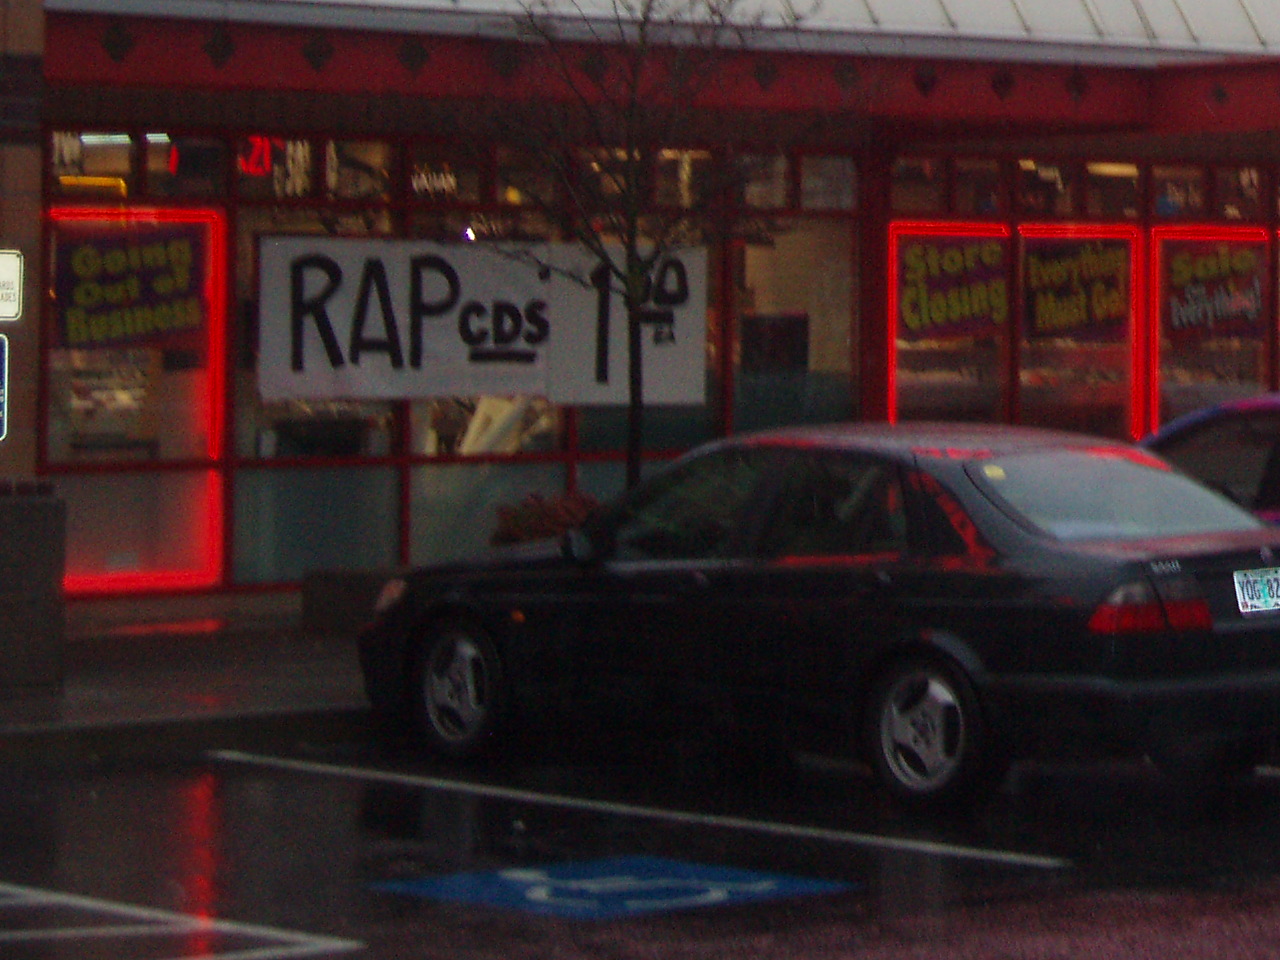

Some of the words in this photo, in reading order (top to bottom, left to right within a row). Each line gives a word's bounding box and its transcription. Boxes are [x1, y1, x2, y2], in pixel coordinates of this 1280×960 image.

[904, 242, 1003, 281] Store
[290, 254, 461, 371] RAP
[901, 279, 1008, 331] Closing
